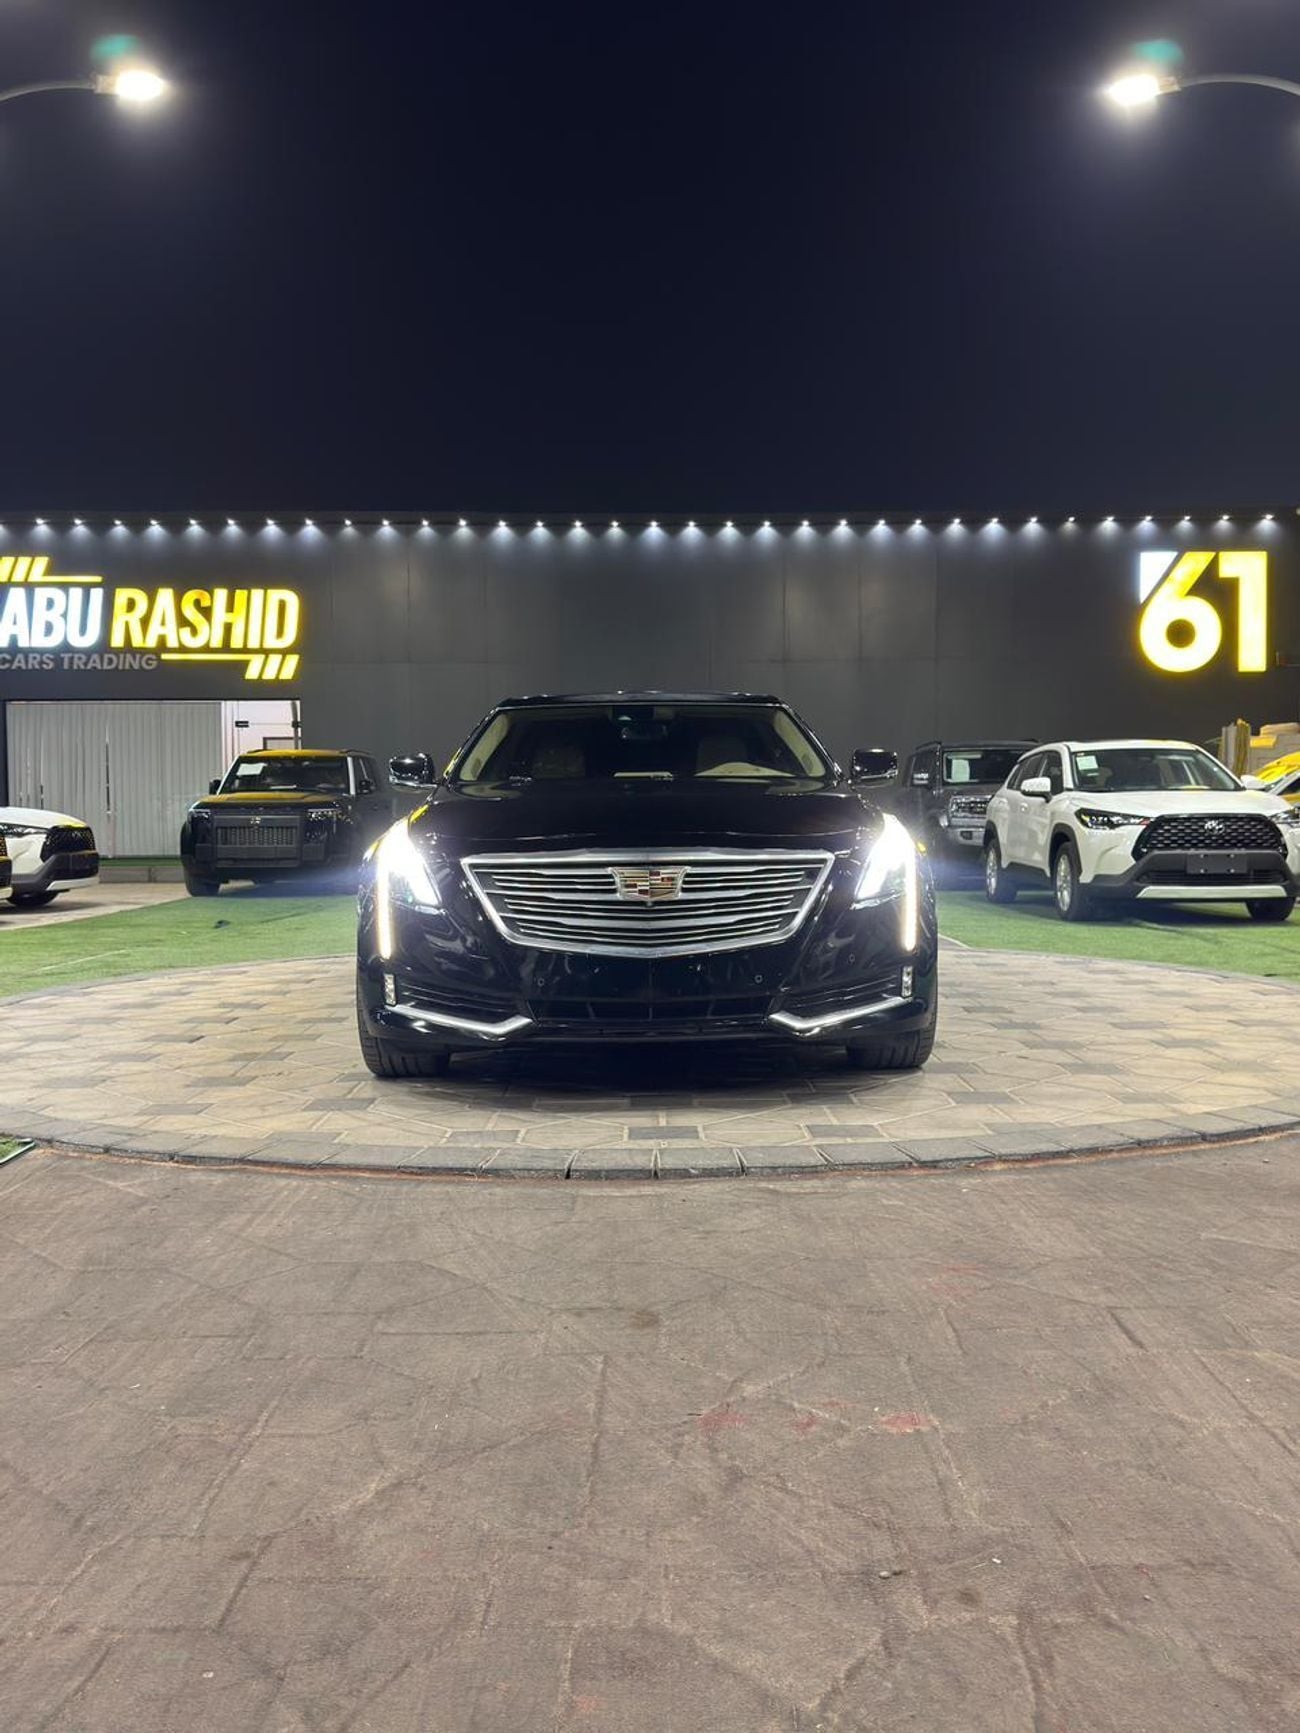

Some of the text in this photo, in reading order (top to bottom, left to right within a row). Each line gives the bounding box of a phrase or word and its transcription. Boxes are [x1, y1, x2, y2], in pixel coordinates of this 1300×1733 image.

[0, 587, 300, 649] ABU RASHID
[1139, 551, 1268, 673] 61
[0, 653, 158, 670] CARS TRADING
